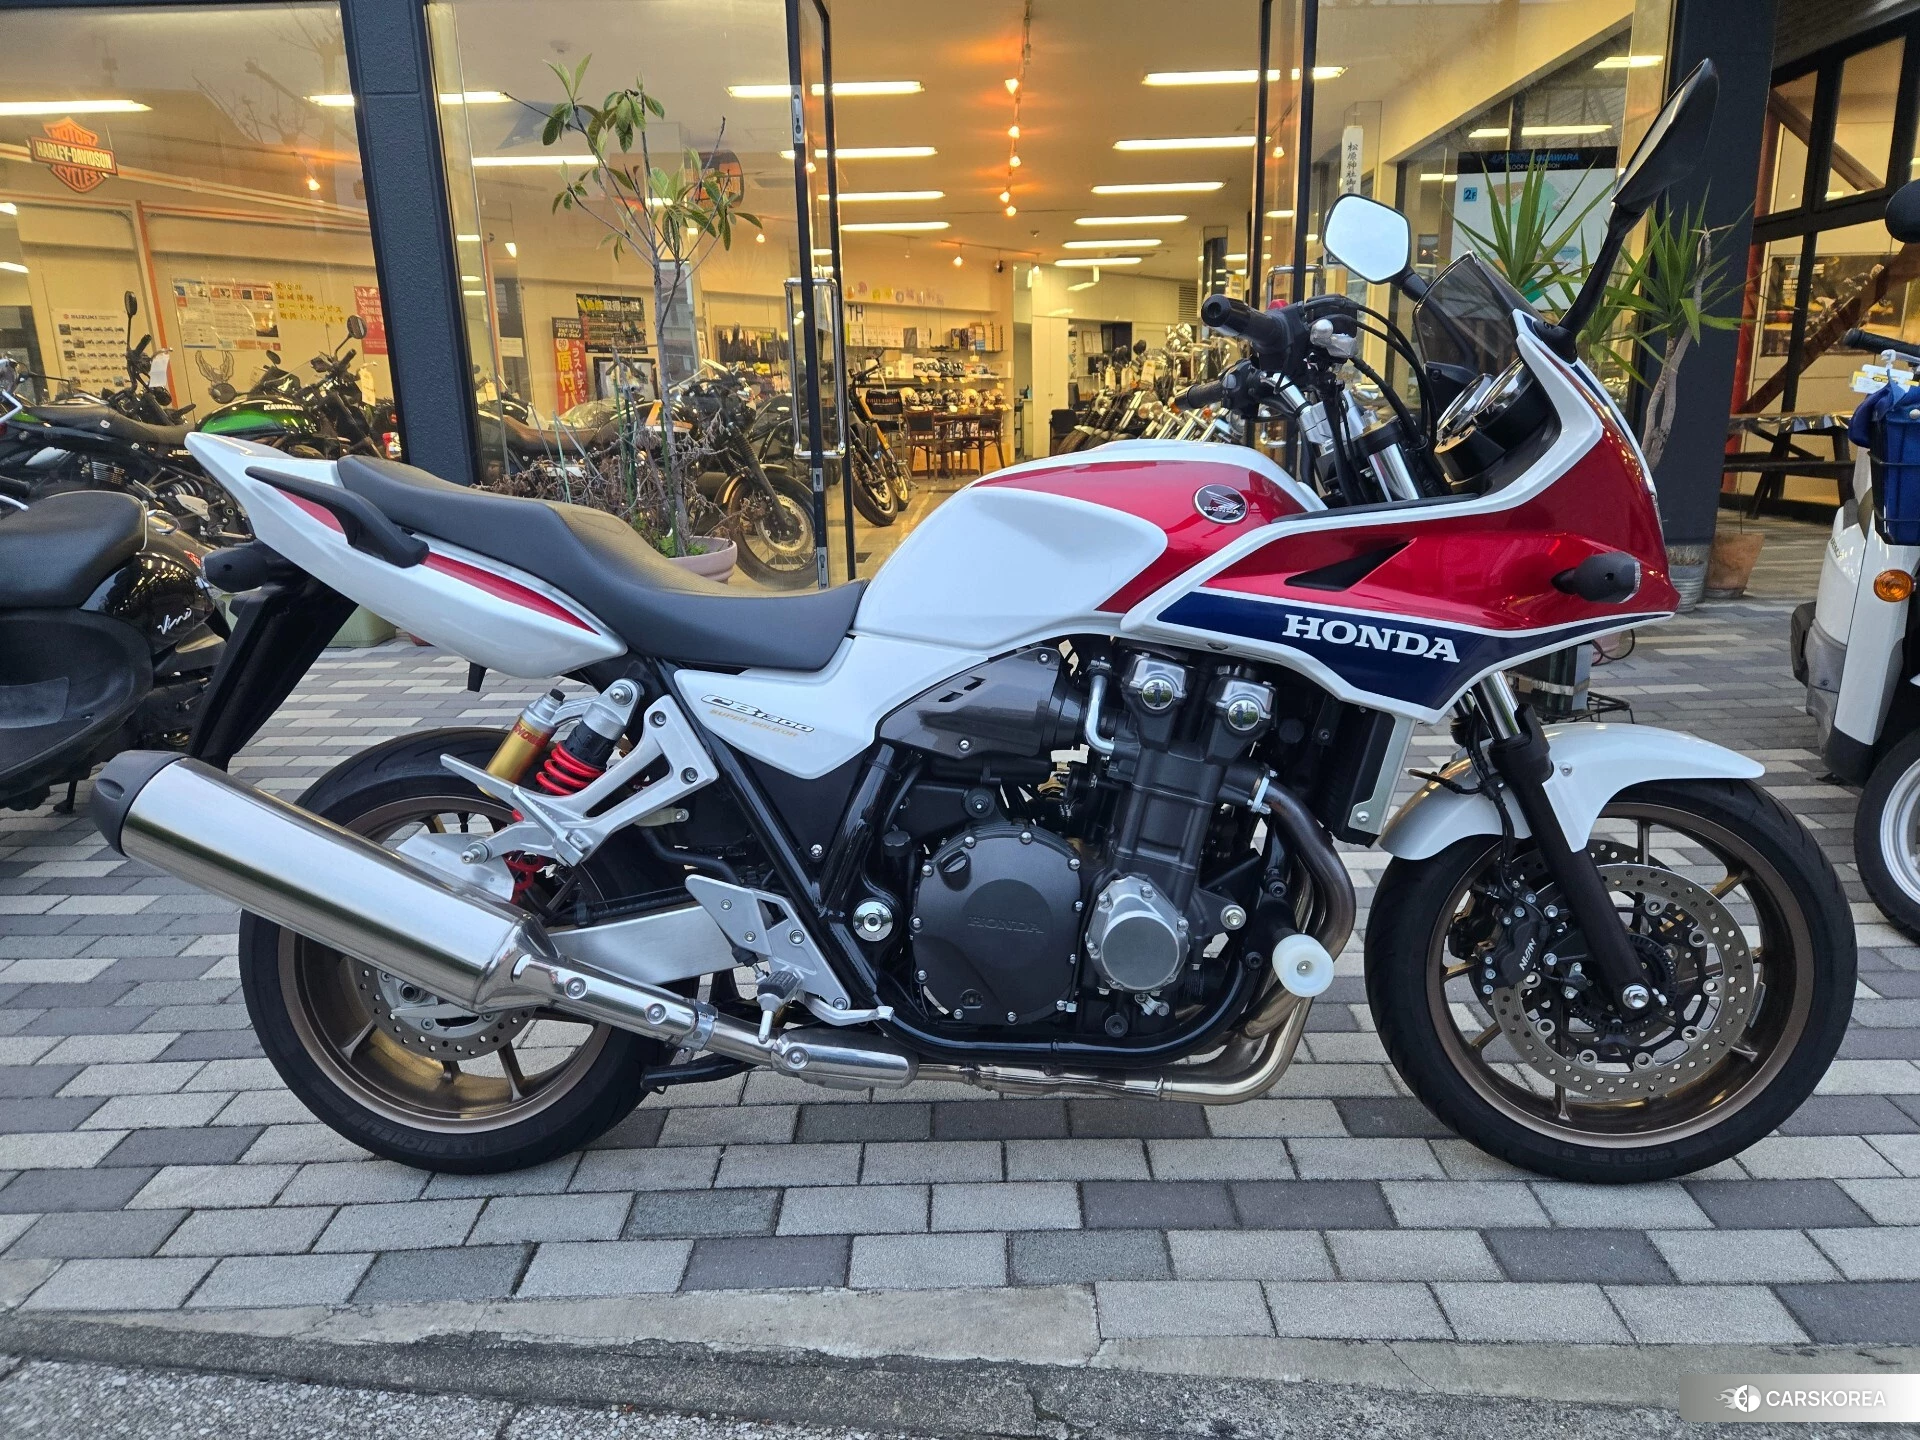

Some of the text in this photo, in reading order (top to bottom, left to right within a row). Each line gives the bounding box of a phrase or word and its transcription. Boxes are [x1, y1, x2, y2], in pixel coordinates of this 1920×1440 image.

[51, 124, 94, 146] MOTOR
[35, 140, 113, 170] HARLEY-DAVIDSON
[57, 164, 98, 188] CYCLES
[1464, 188, 1477, 200] 2F
[1282, 614, 1461, 663] HONDA
[709, 708, 748, 723] SUPER
[967, 916, 1044, 934] HONDA
